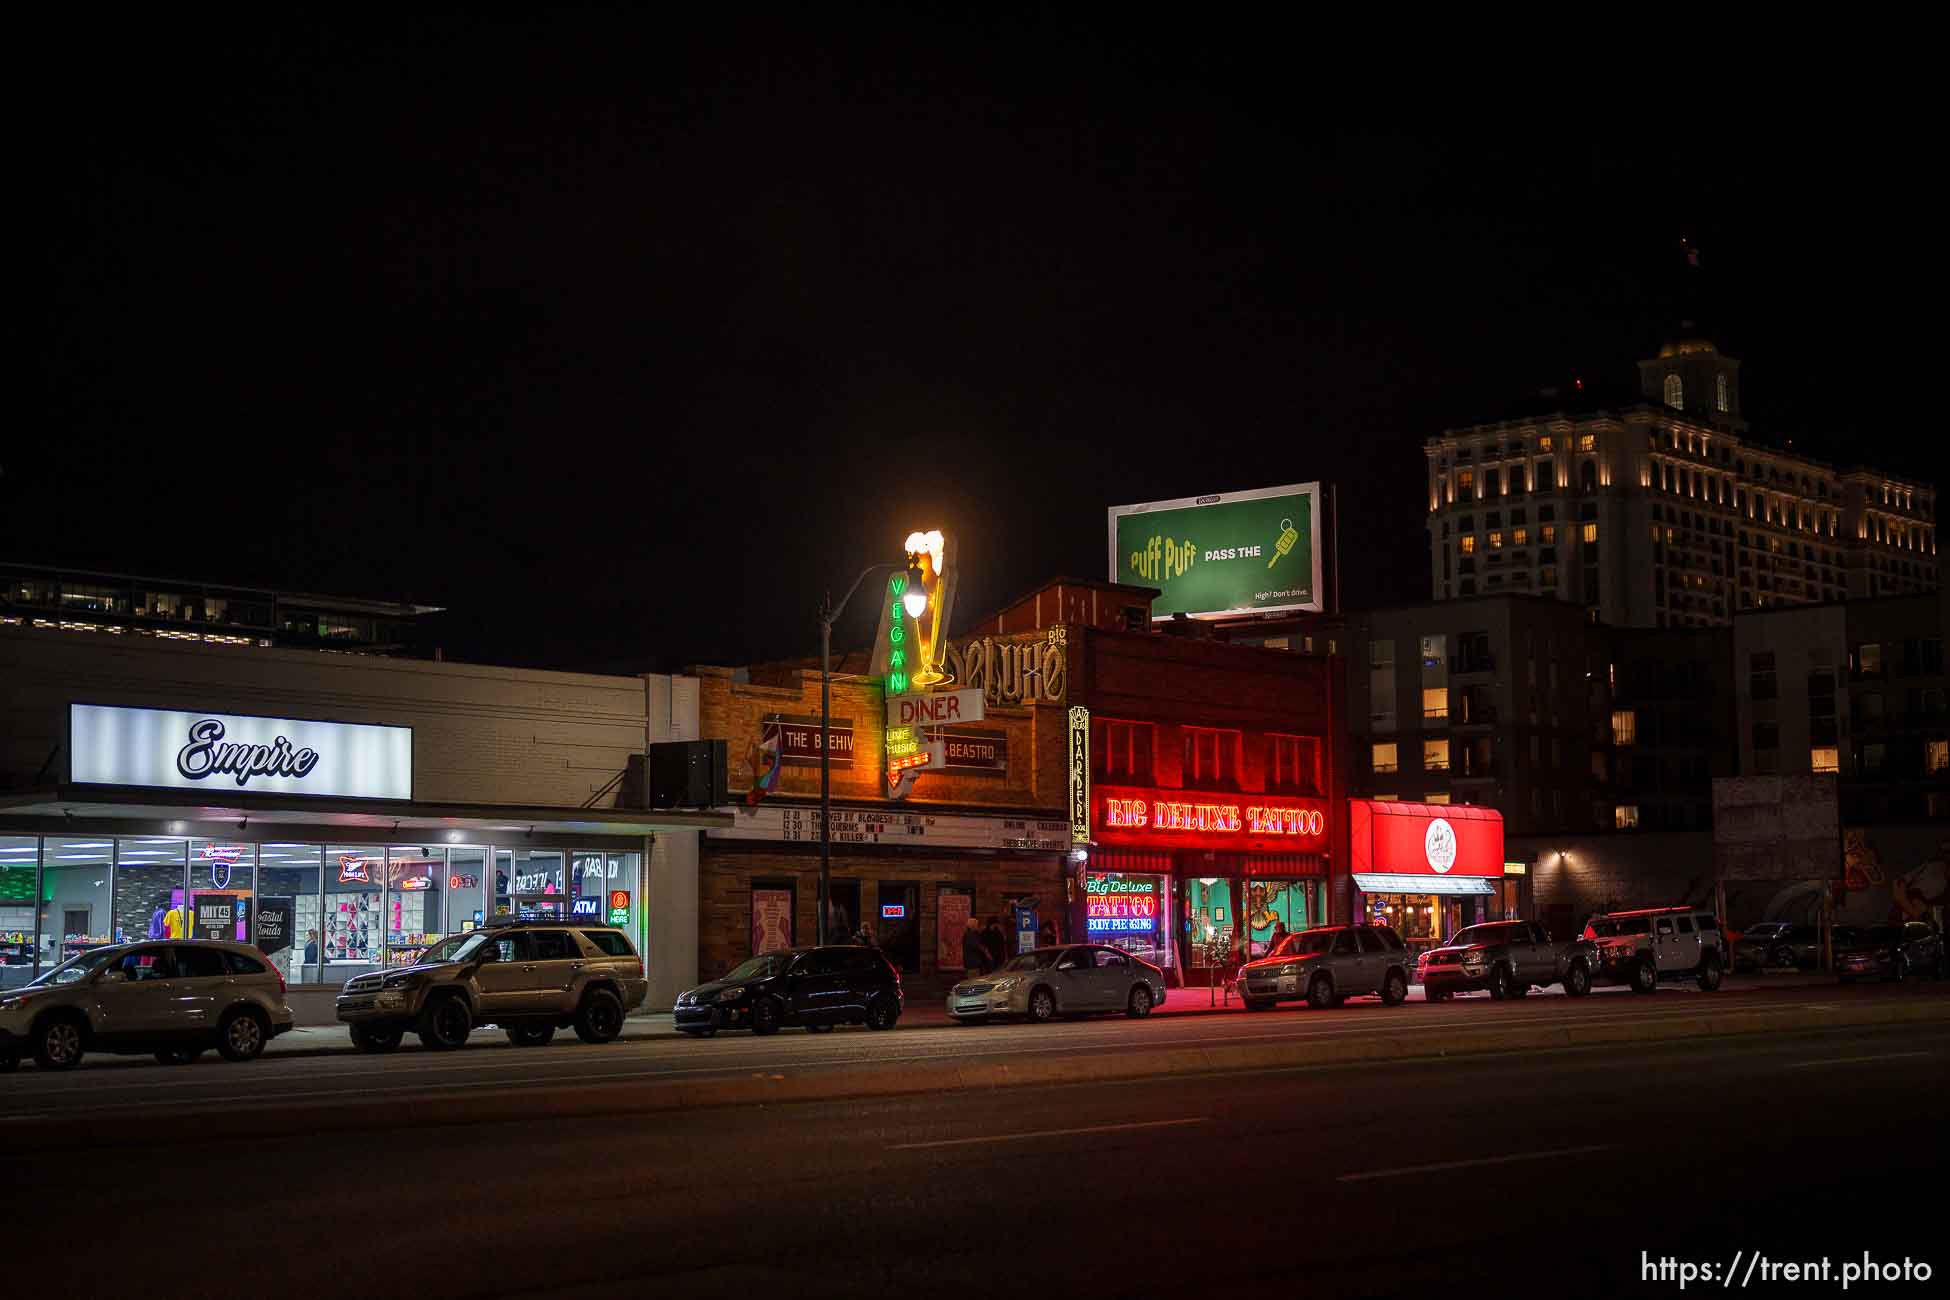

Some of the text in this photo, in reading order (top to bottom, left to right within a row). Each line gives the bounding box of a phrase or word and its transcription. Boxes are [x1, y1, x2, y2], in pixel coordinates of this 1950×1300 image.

[1237, 545, 1261, 558] THE
[890, 579, 904, 691] VEGAN
[900, 696, 960, 723] DINER
[786, 731, 808, 748] THE
[177, 719, 320, 787] Empire
[1106, 798, 1324, 836] BIG DELUXE TATTOO
[1110, 881, 1153, 893] Deluxe
[573, 900, 597, 914] ATM
[1087, 895, 1155, 917] TATTOO
[610, 915, 628, 924] HERE
